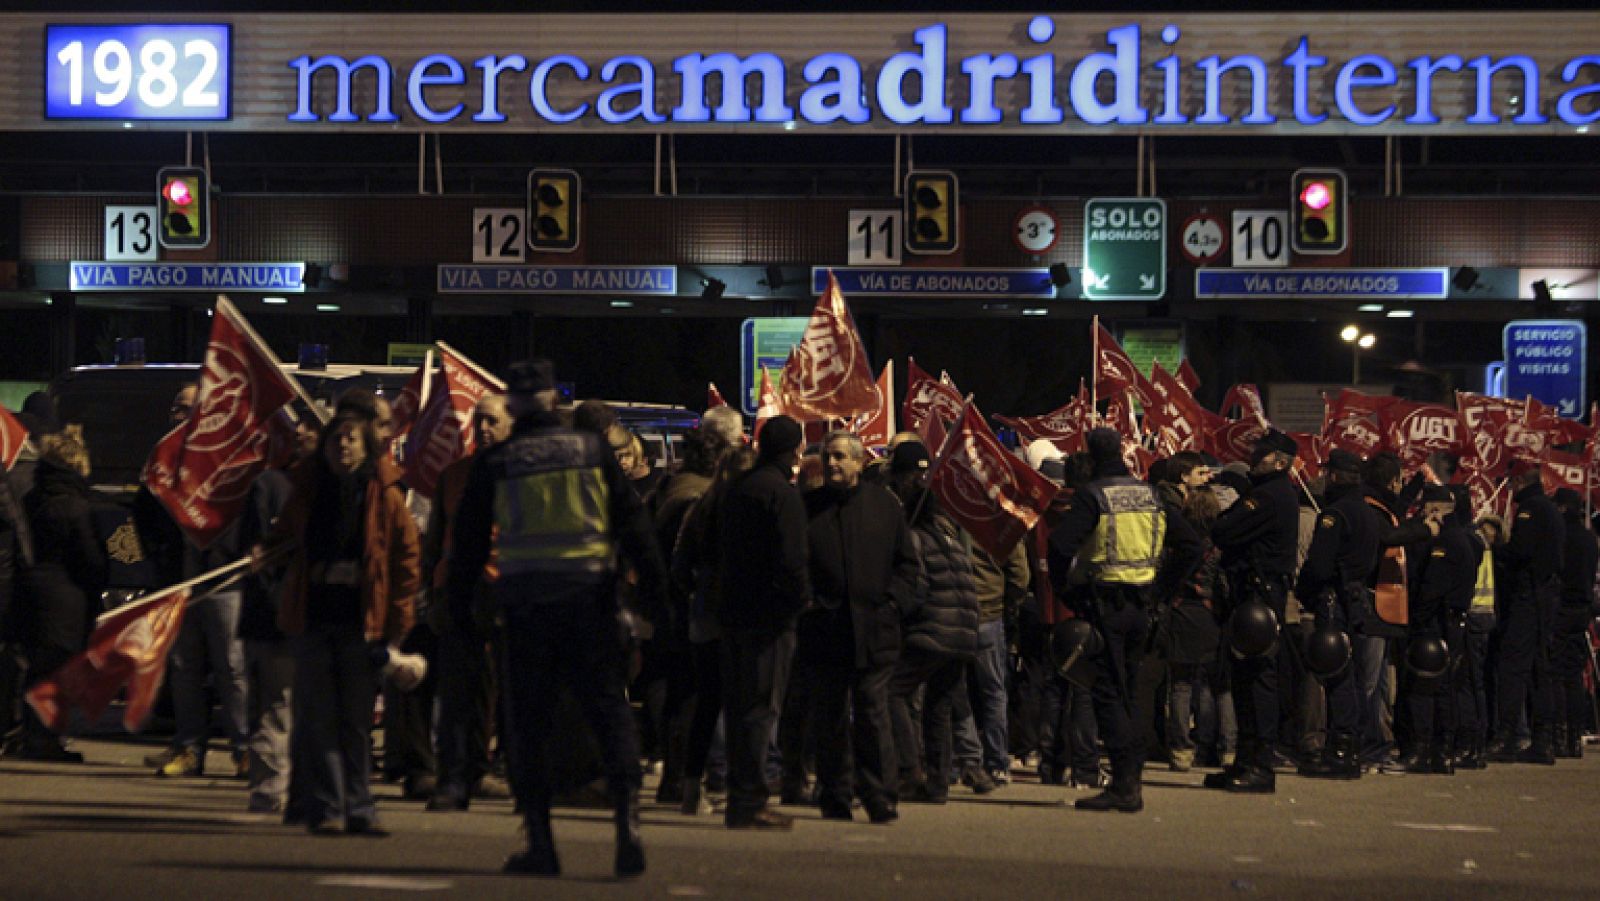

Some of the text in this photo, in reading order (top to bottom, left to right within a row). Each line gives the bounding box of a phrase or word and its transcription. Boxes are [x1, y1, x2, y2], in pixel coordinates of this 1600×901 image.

[56, 38, 221, 109] 1982
[1091, 208, 1160, 228] SOLO
[110, 212, 152, 254] 13
[478, 214, 521, 257] 12
[857, 215, 896, 259] 11
[1090, 231, 1160, 241] ABONADOS
[1237, 216, 1282, 261] 10
[77, 266, 299, 287] VIA PAGO MANUAL
[445, 270, 670, 289] VIA PAGO MANUAL
[890, 275, 911, 289] DE
[916, 275, 1010, 292] ABONADOS
[1276, 277, 1297, 292] DE
[1301, 276, 1399, 293] ABONADOS
[1514, 329, 1575, 341] SERVICIO
[1518, 363, 1570, 374] VISITAS
[1410, 416, 1458, 442] UGT
